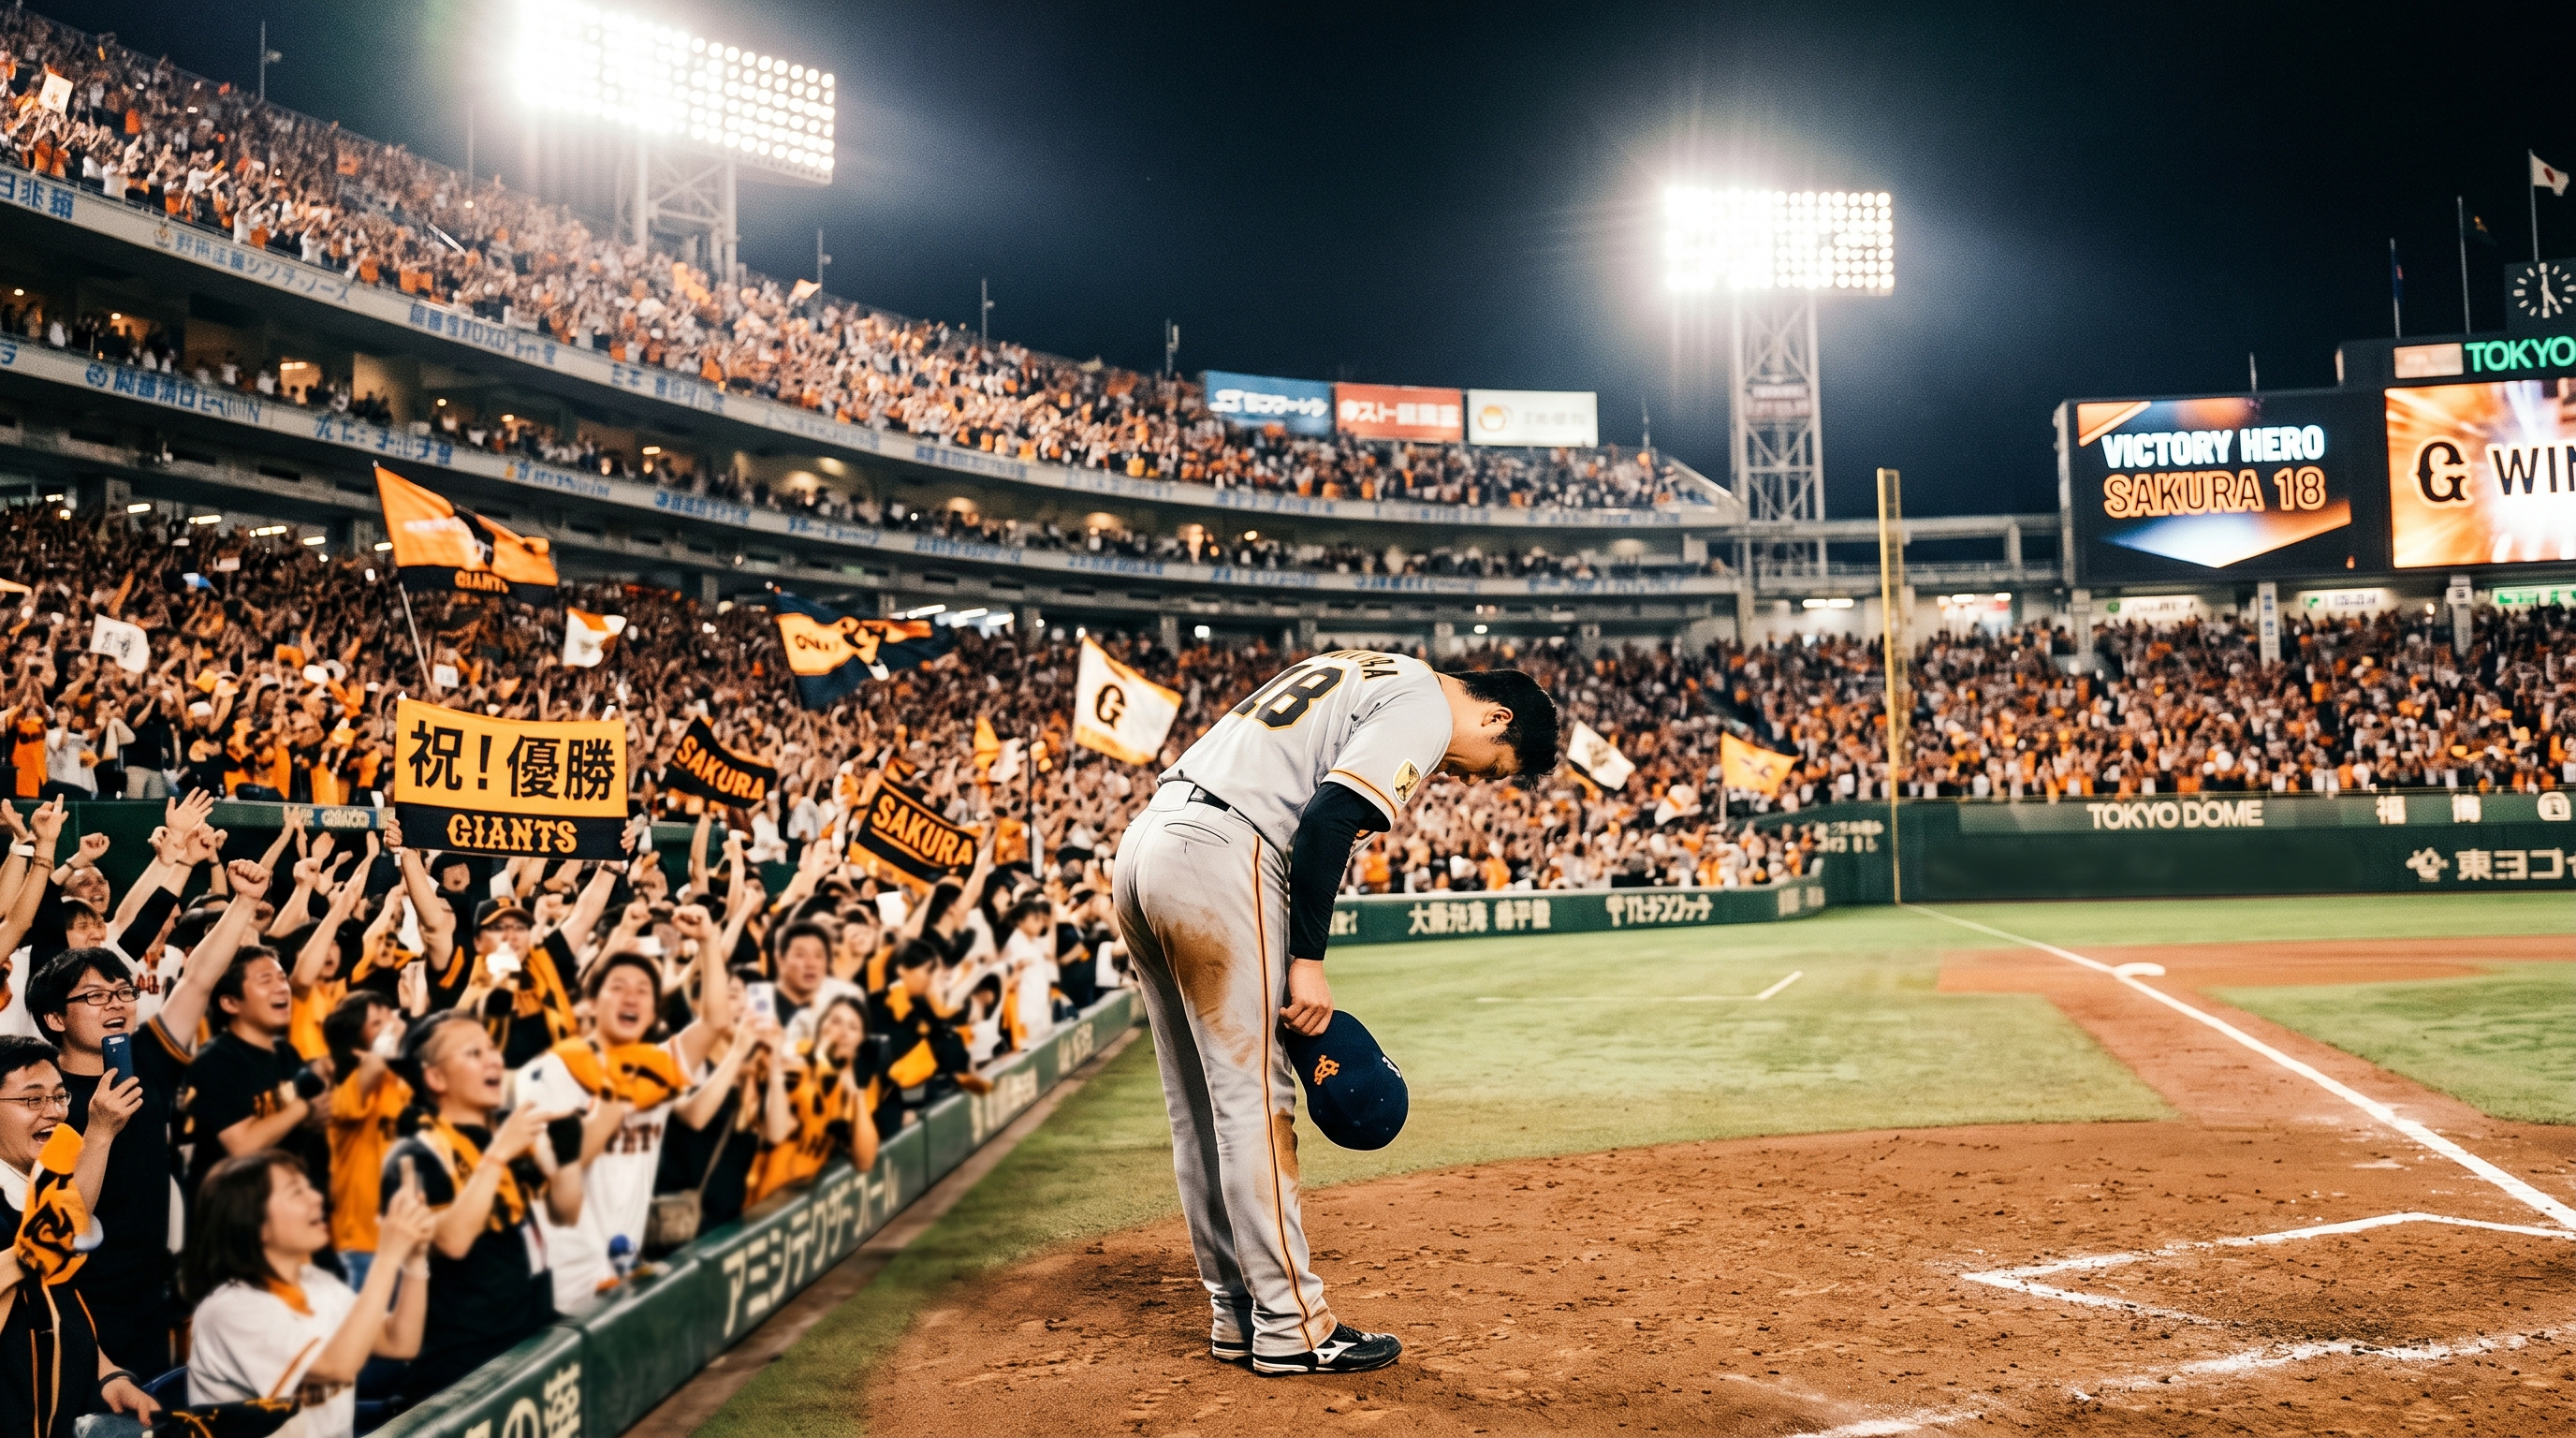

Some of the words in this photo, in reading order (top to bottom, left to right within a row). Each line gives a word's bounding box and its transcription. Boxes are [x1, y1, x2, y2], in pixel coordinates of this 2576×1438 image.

[2465, 336, 2576, 373] TOKYO
[2101, 429, 2233, 468] VICTORY
[2239, 424, 2326, 462] HERO
[2103, 469, 2265, 519] SAKURA
[2274, 466, 2327, 511] 18
[2414, 439, 2470, 505] G
[1095, 683, 1126, 729] G
[408, 720, 616, 801] 祝！優勝
[676, 735, 765, 800] SAKURA
[446, 814, 578, 854] GIANTS
[872, 795, 973, 866] SAKURA
[2086, 801, 2180, 829] TOKYO
[2183, 800, 2264, 828] DOME
[2454, 847, 2576, 881] 東ヨコ
